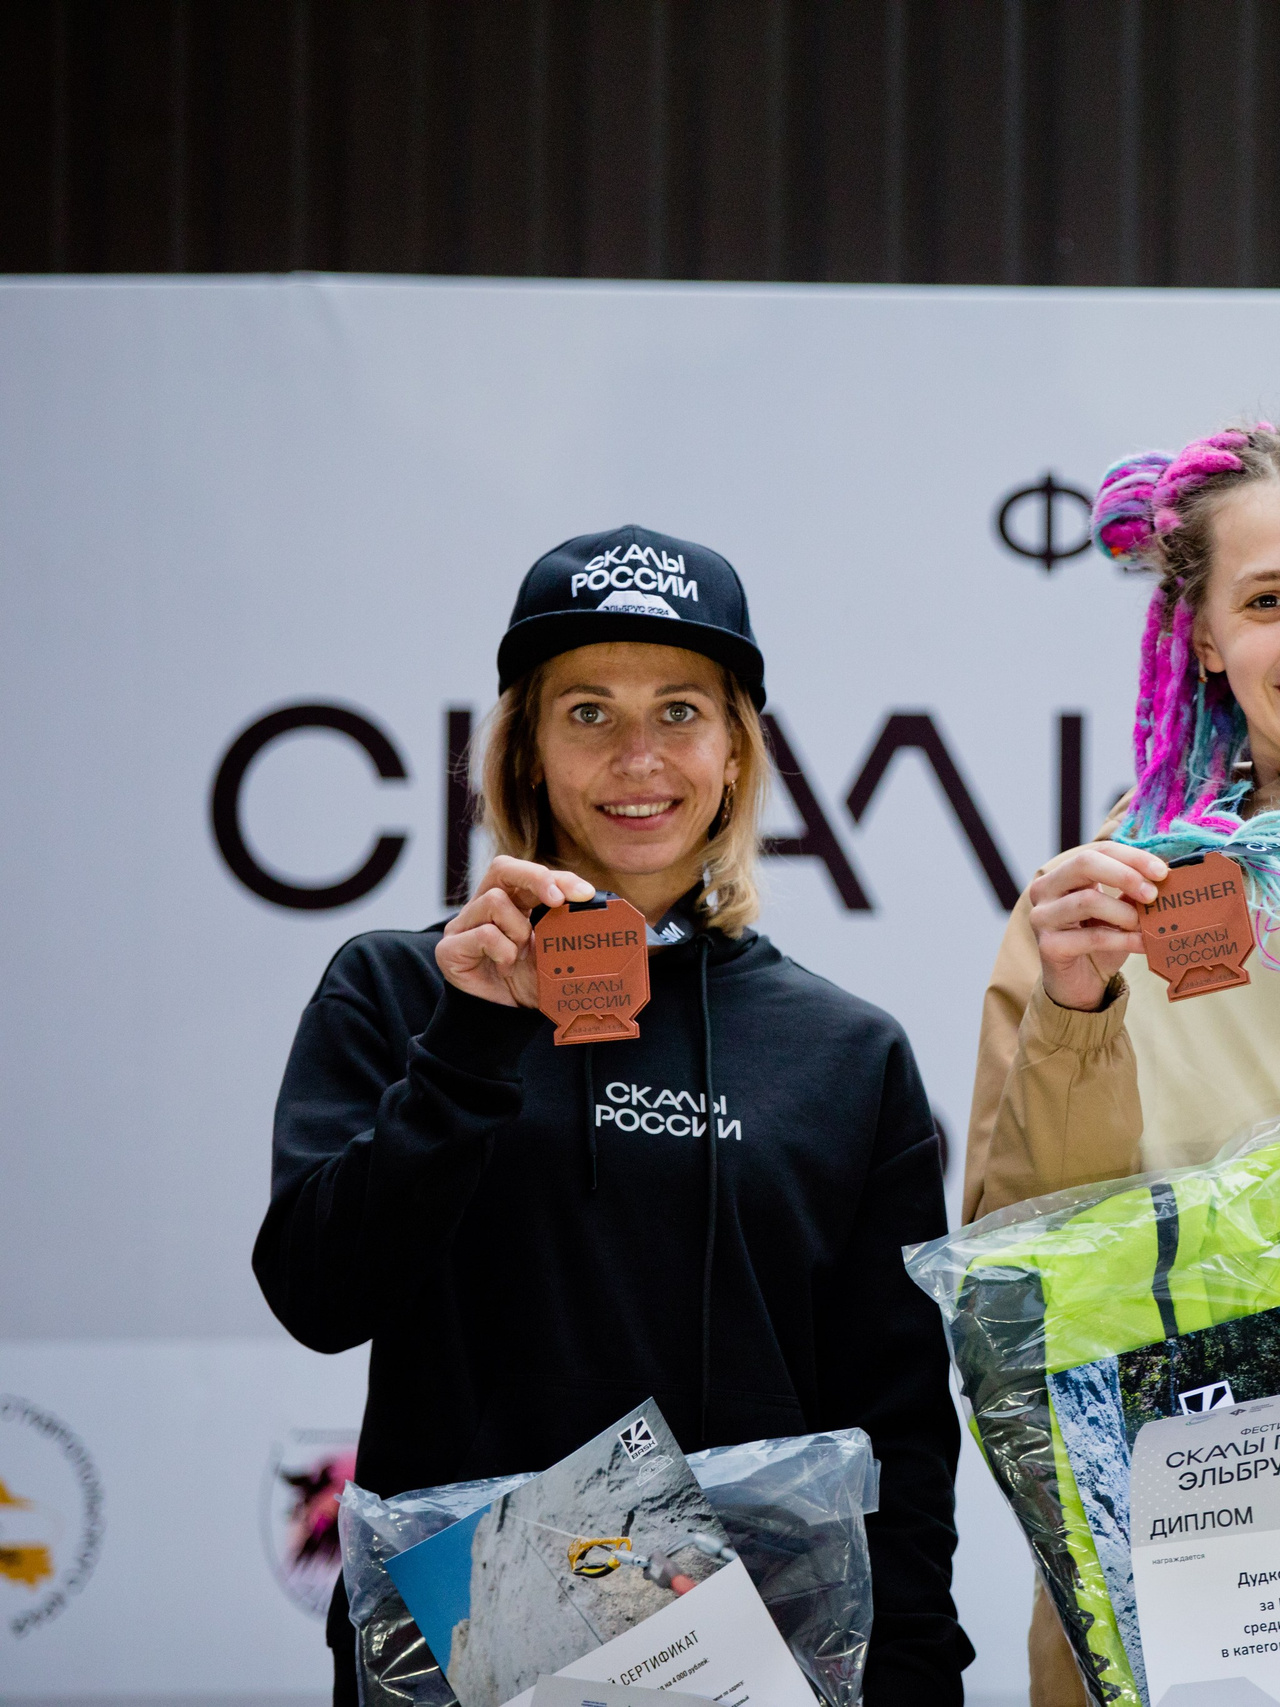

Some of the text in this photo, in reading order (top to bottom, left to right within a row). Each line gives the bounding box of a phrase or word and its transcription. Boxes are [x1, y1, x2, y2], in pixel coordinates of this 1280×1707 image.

[584, 543, 686, 575] СКАЛЫ
[571, 565, 699, 602] РОССИИ
[647, 606, 670, 616] 2024
[208, 704, 1140, 914] САЛ
[1144, 880, 1237, 915] FINISHER
[542, 930, 639, 953] FINISHER
[1169, 928, 1230, 952] СКАЛЫ
[1165, 941, 1238, 969] РОССИИ
[562, 979, 624, 996] СКАЛЫ
[557, 994, 632, 1012] РОССИИ
[605, 1081, 727, 1115] СКАЛЫ
[595, 1104, 742, 1141] РОССИИ
[631, 1440, 656, 1460] BASK
[1166, 1437, 1265, 1468] СКАЛЫ
[1150, 1506, 1253, 1541] ДИПЛОМ
[1152, 1552, 1206, 1566] награждается
[1259, 1600, 1275, 1612] за
[620, 1630, 699, 1686] СЕРТИФИКАТ
[1221, 1648, 1230, 1658] в
